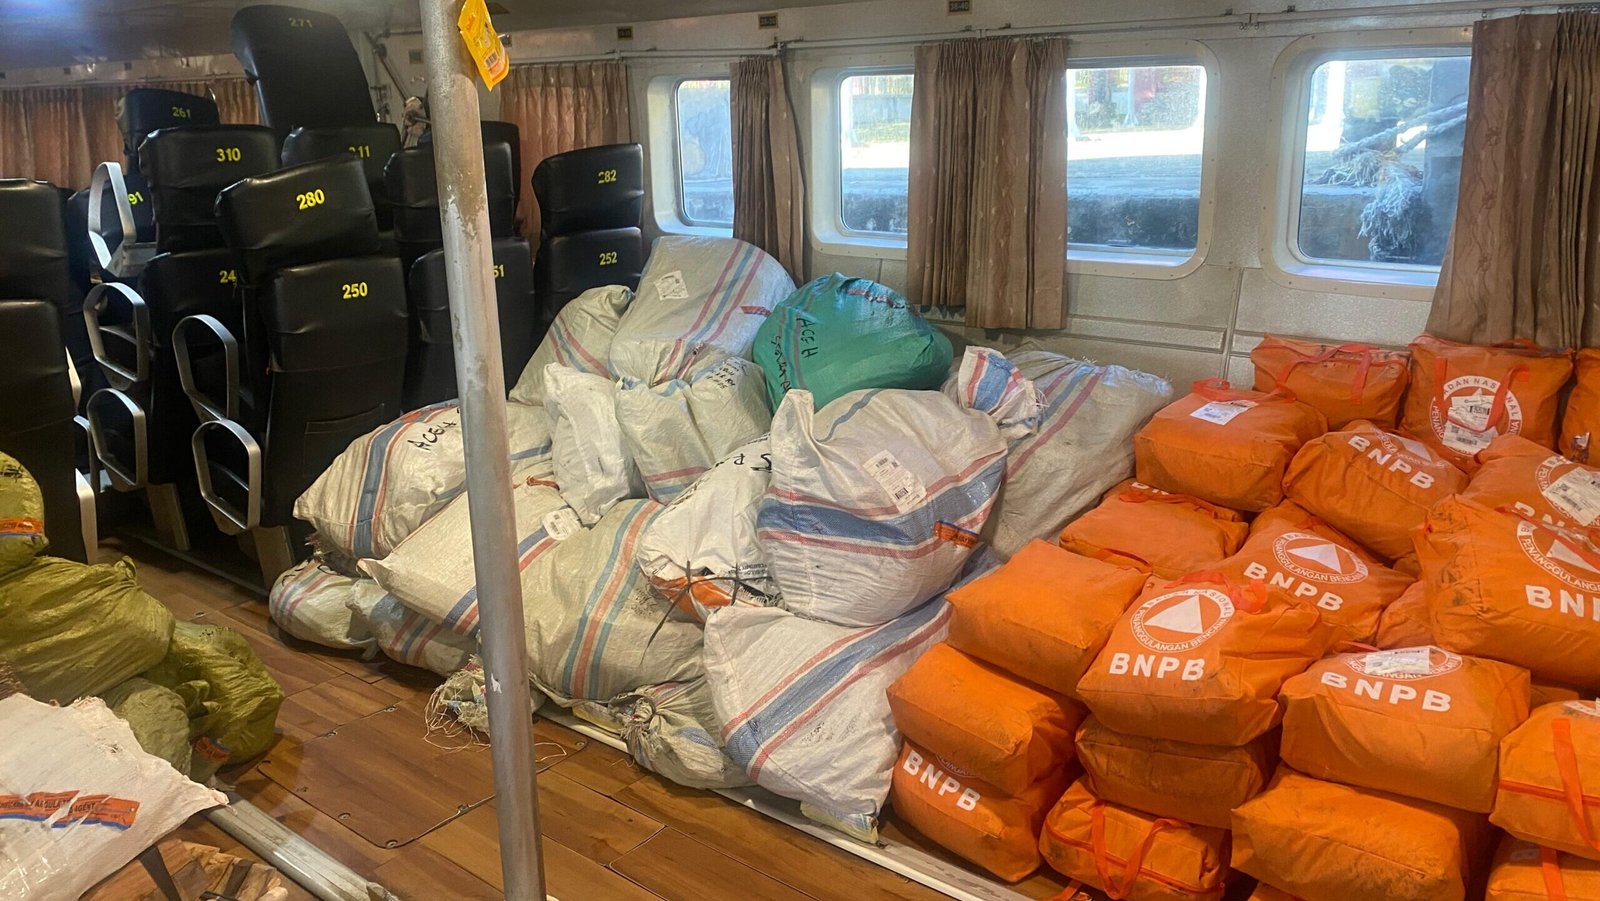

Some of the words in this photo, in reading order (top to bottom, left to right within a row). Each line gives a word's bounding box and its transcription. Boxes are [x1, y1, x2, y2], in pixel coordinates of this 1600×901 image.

[288, 17, 313, 28] 271
[172, 106, 191, 119] 261
[216, 147, 241, 162] 310
[598, 169, 617, 184] 282
[128, 191, 144, 205] 91
[296, 189, 325, 210] 280
[599, 251, 618, 266] 252
[219, 270, 236, 284] 24
[342, 282, 368, 299] 250
[796, 317, 819, 358] ACEH
[1348, 435, 1435, 489] BNPB
[1243, 561, 1344, 611] BNPB
[1109, 652, 1205, 681] BNPB
[1320, 671, 1451, 712] BNPB
[903, 749, 981, 811] BNPB
